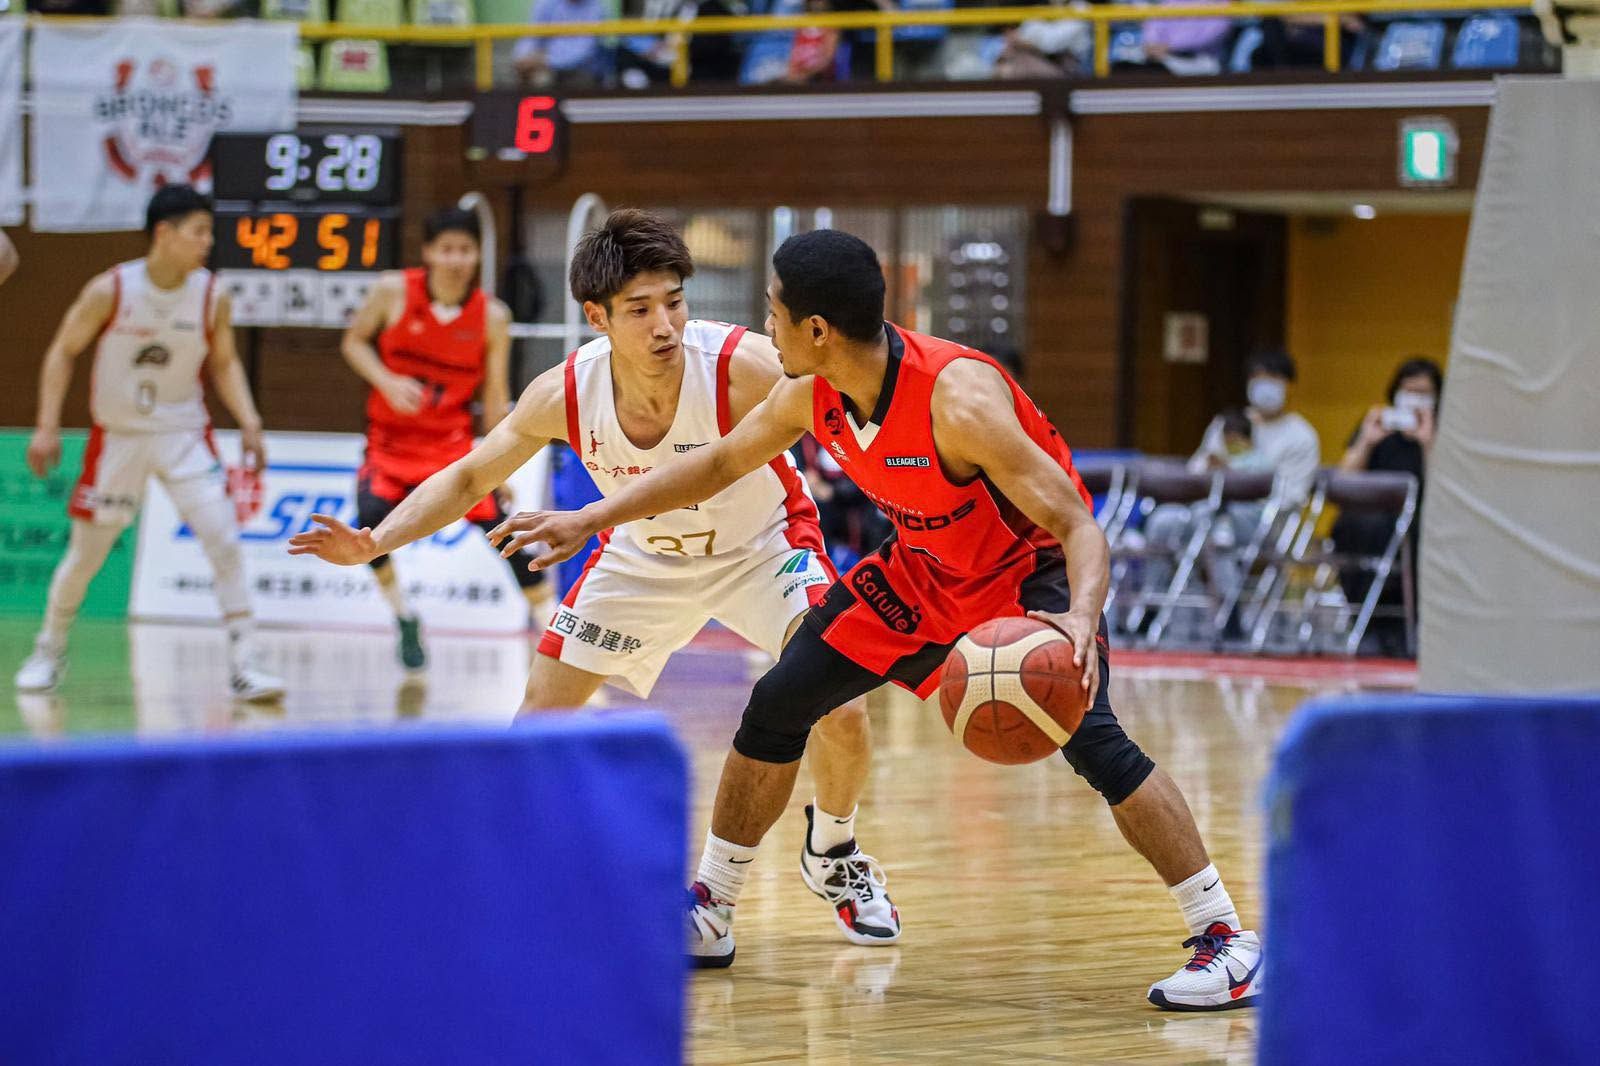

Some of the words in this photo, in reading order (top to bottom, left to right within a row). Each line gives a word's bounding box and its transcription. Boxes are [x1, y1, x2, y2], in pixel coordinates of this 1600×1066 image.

[515, 97, 556, 153] 6
[265, 134, 382, 191] 9:28
[236, 213, 298, 270] 42
[318, 213, 380, 270] 51
[886, 458, 917, 466] B.LEAGUE
[646, 529, 717, 557] 37
[555, 610, 642, 654] 西濃建設
